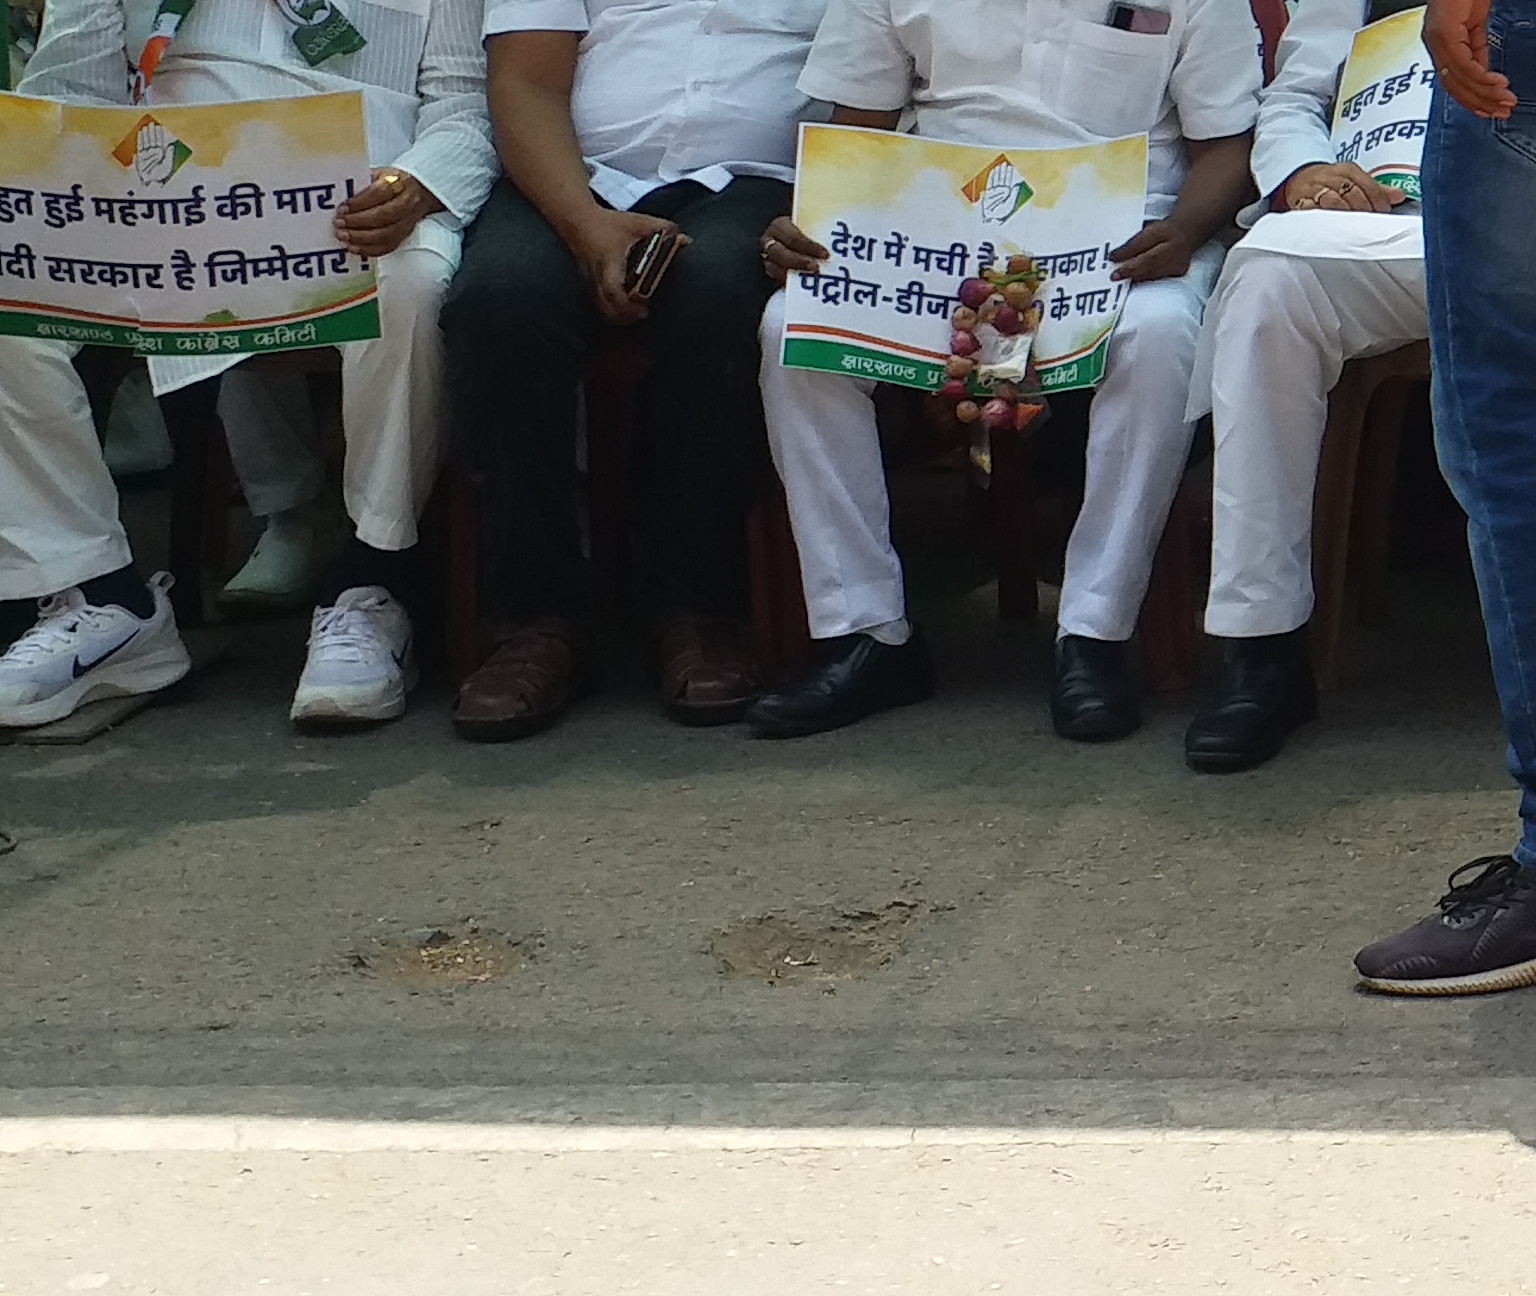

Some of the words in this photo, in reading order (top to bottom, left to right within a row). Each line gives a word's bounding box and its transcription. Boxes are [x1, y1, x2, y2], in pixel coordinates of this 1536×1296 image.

[1341, 82, 1380, 122] बहुत
[1378, 63, 1420, 106] हुई
[41, 184, 84, 229] हुई
[91, 185, 206, 227] महंगाई
[214, 182, 265, 221] की
[44, 255, 164, 290] सरकार
[171, 249, 196, 292] है
[831, 221, 877, 262] देश
[884, 231, 910, 268] में
[913, 242, 970, 278] मची
[1050, 287, 1071, 321] के
